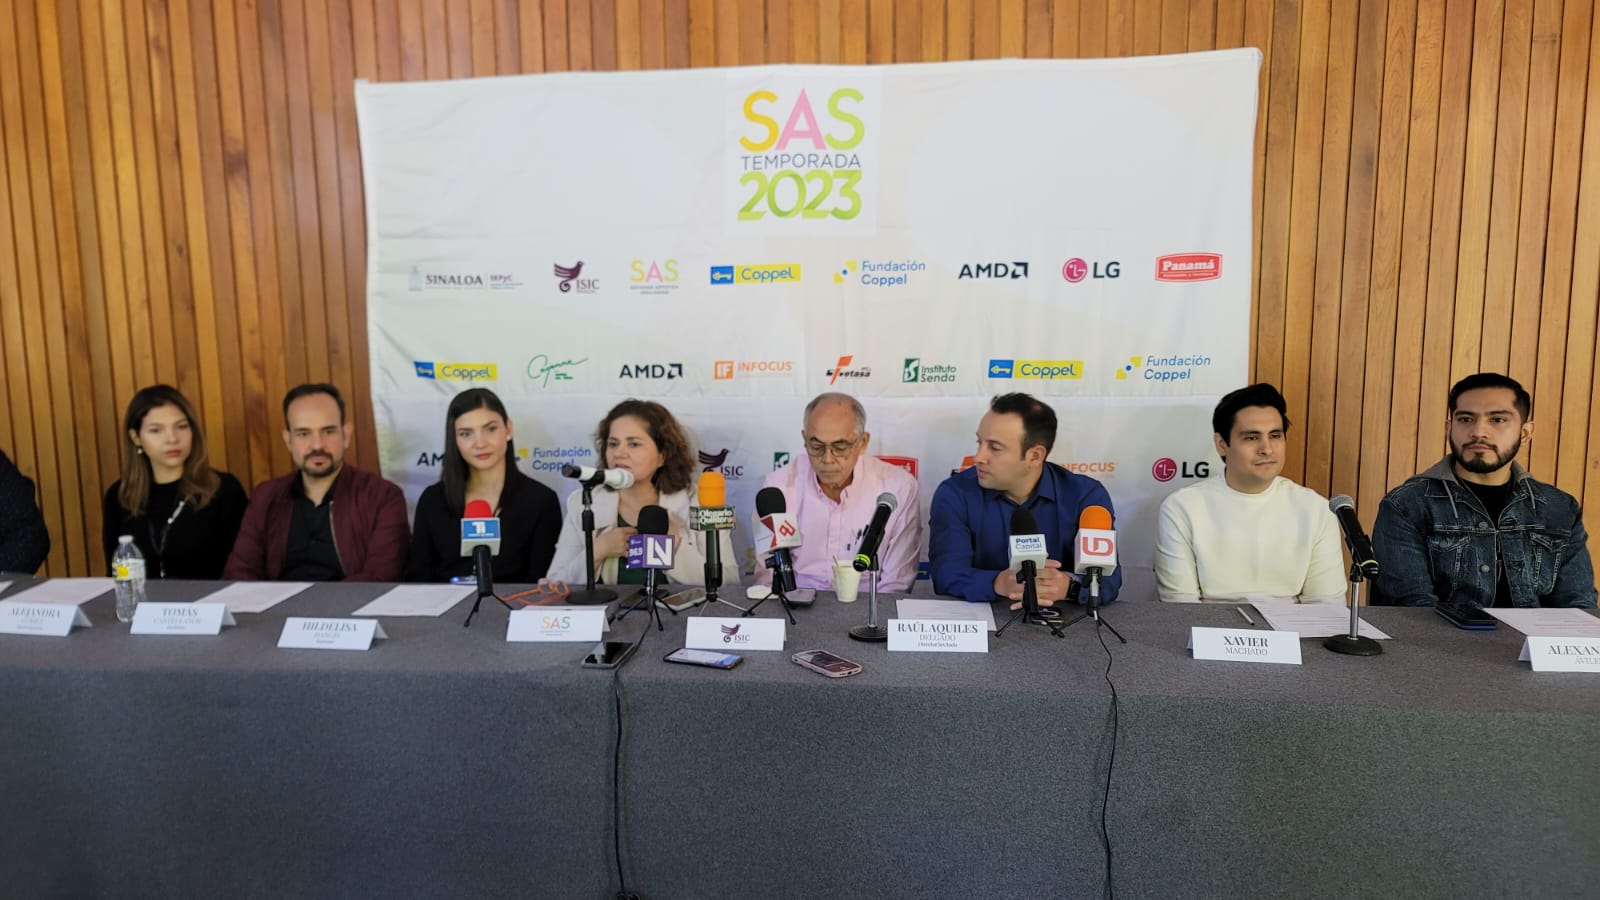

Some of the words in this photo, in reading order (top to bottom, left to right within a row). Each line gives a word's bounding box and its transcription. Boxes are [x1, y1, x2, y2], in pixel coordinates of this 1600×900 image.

[739, 87, 865, 152] SAS
[740, 153, 862, 171] TEMPORADA
[737, 169, 863, 221] 2023
[630, 259, 679, 283] SAS
[861, 260, 925, 272] Fundación
[958, 263, 1008, 279] AMD
[1093, 261, 1120, 278] LG
[1162, 259, 1215, 271] Panamá
[425, 274, 483, 285] SINALOA
[741, 267, 794, 284] Coppel
[861, 273, 907, 287] Coppel
[576, 279, 600, 290] ISIC
[738, 361, 793, 372] INFOCUS
[1146, 355, 1211, 367] Fundación
[441, 365, 491, 380] Coppel
[619, 364, 665, 379] AMD
[921, 365, 957, 373] Instituto
[1020, 363, 1076, 379] Coppel
[1144, 368, 1191, 381] Coppel
[920, 373, 956, 383] Senda
[532, 446, 592, 458] Fundación
[417, 452, 446, 467] AM
[531, 459, 575, 472] Copp
[1181, 461, 1210, 478] LG
[540, 616, 571, 630] SAS
[928, 623, 979, 635] AQUILES
[919, 634, 957, 642] DELGADO
[1223, 635, 1269, 648] XAVIER
[1225, 647, 1269, 657] MACHADO
